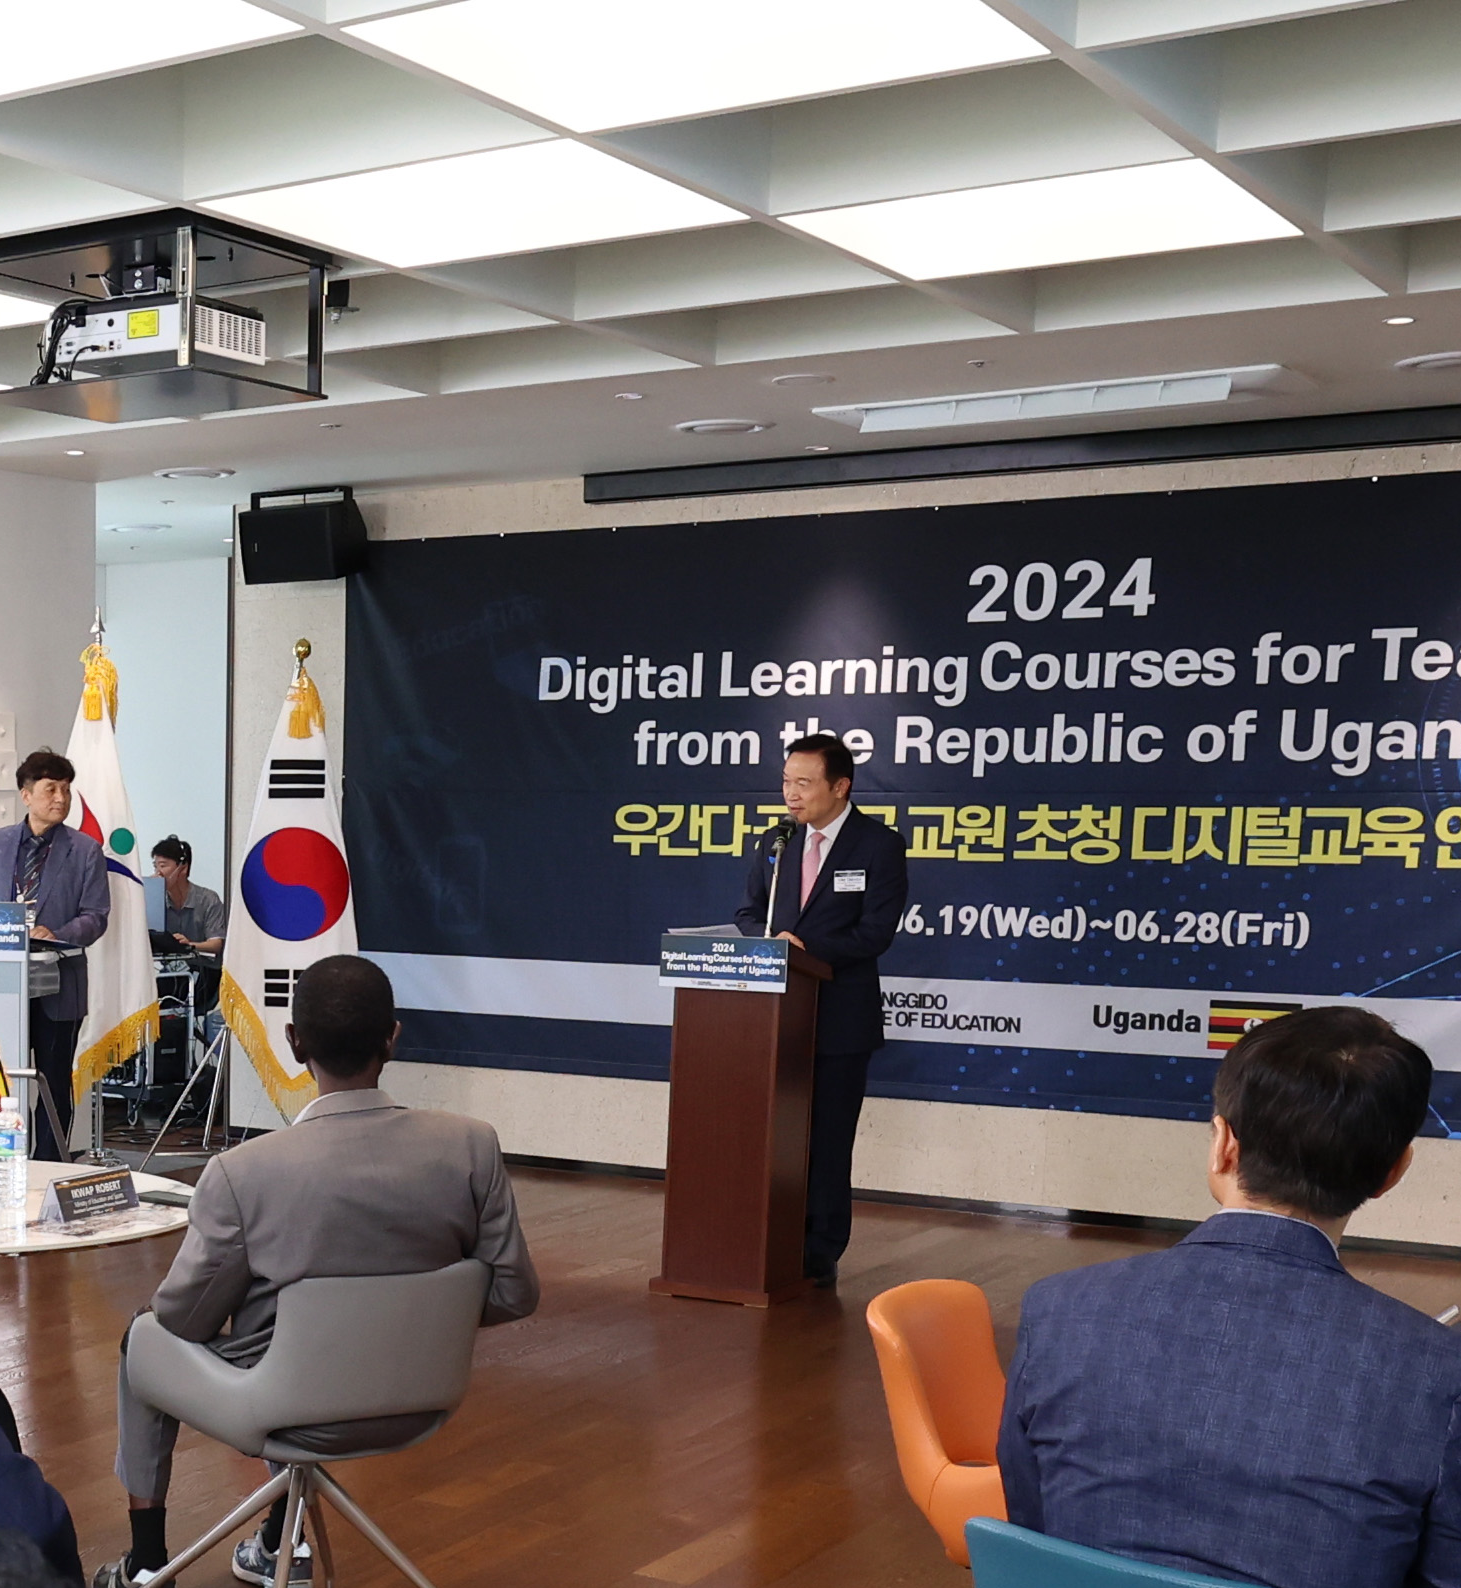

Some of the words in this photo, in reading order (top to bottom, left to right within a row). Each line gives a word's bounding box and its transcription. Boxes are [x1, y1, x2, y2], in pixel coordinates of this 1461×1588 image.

[967, 557, 1156, 623] 2024
[538, 652, 703, 713] Digital
[719, 645, 968, 707] Learning
[980, 641, 1236, 692] Courses
[1253, 632, 1355, 684] for
[634, 720, 760, 765] from
[894, 712, 1164, 778] Republic
[1186, 710, 1257, 762] of
[906, 806, 1006, 862] 교원
[1013, 803, 1122, 864] 초청
[1131, 806, 1426, 868] 디지털교육
[712, 943, 735, 952] 2024
[667, 962, 686, 970] from
[688, 963, 701, 971] the
[703, 964, 736, 974] Republic
[738, 966, 747, 974] of
[749, 967, 780, 976] Uganda
[894, 1012, 920, 1029] OF
[921, 1012, 1021, 1034] EDUCATION
[1092, 1004, 1202, 1035] Uganda
[95, 1180, 121, 1193] ROBERT
